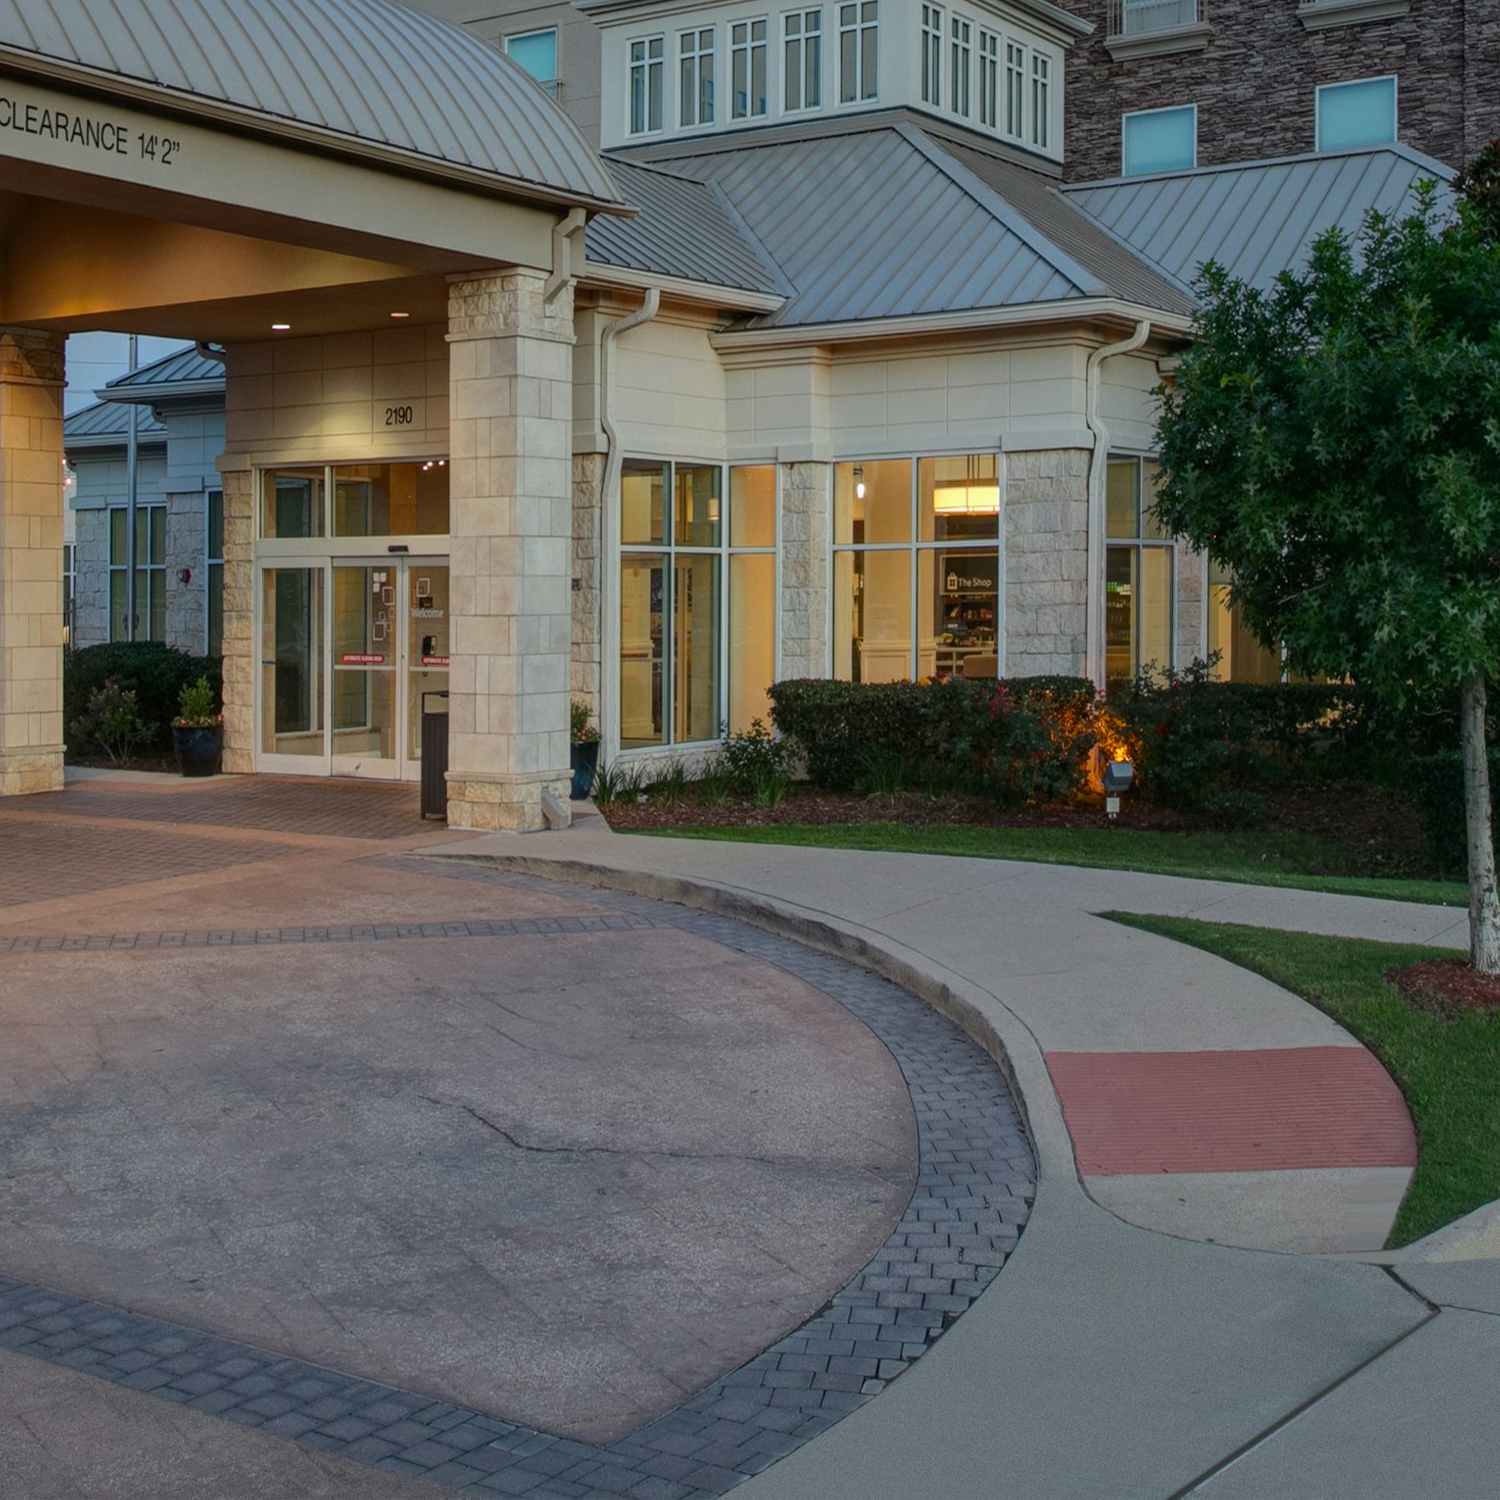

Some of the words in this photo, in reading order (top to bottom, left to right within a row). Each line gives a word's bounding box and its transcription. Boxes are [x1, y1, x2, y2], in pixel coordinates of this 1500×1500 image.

[385, 405, 413, 426] 2190
[958, 578, 972, 587] The
[972, 577, 993, 588] Shop
[411, 607, 444, 618] Welcome
